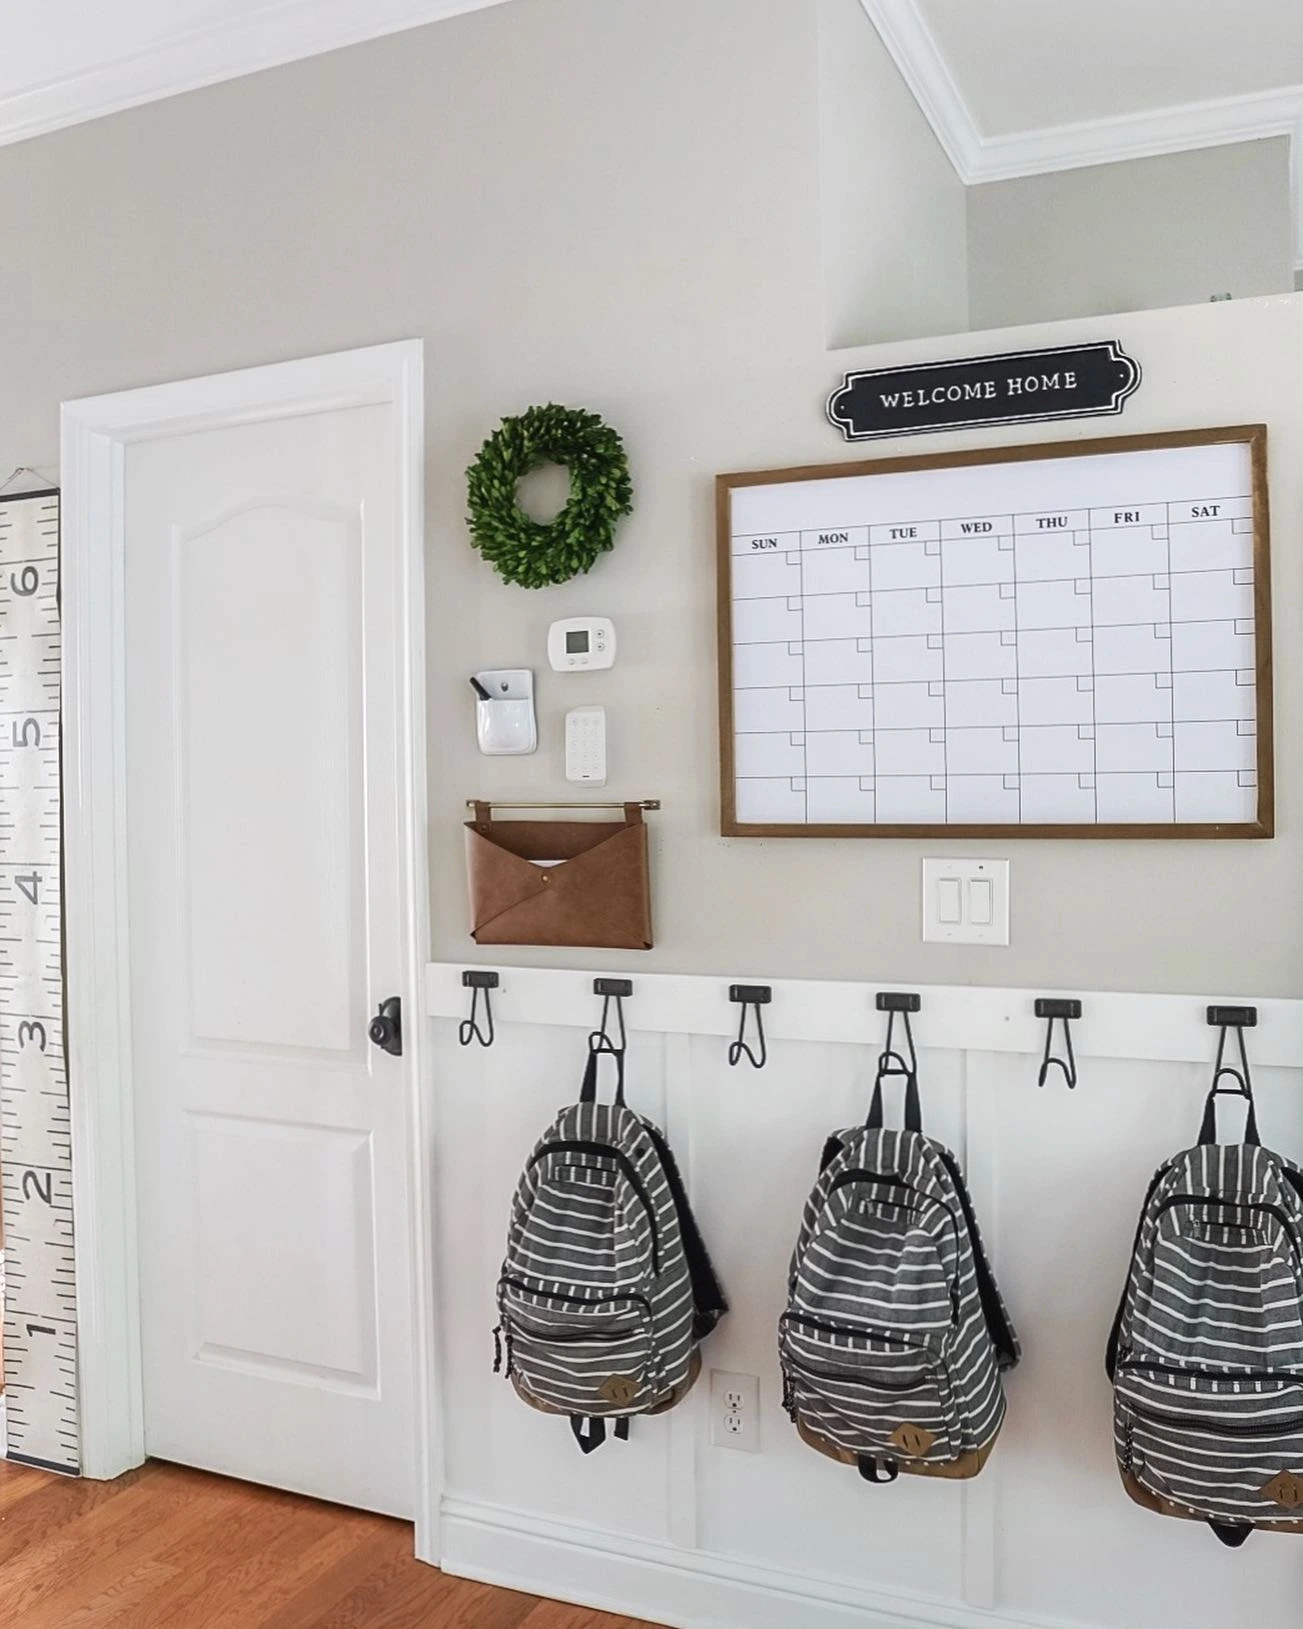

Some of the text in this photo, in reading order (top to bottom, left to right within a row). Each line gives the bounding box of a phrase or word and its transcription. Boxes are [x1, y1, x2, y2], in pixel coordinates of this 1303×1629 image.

[880, 372, 1079, 409] WELCOME HOME
[751, 504, 1221, 551] SUN MON TUE WED THU FRI SAT
[10, 565, 40, 597] 6
[13, 717, 42, 748] 5
[14, 871, 43, 905] 4
[18, 1020, 46, 1052] 3
[22, 1171, 52, 1205] 2
[26, 1323, 57, 1338] 1
